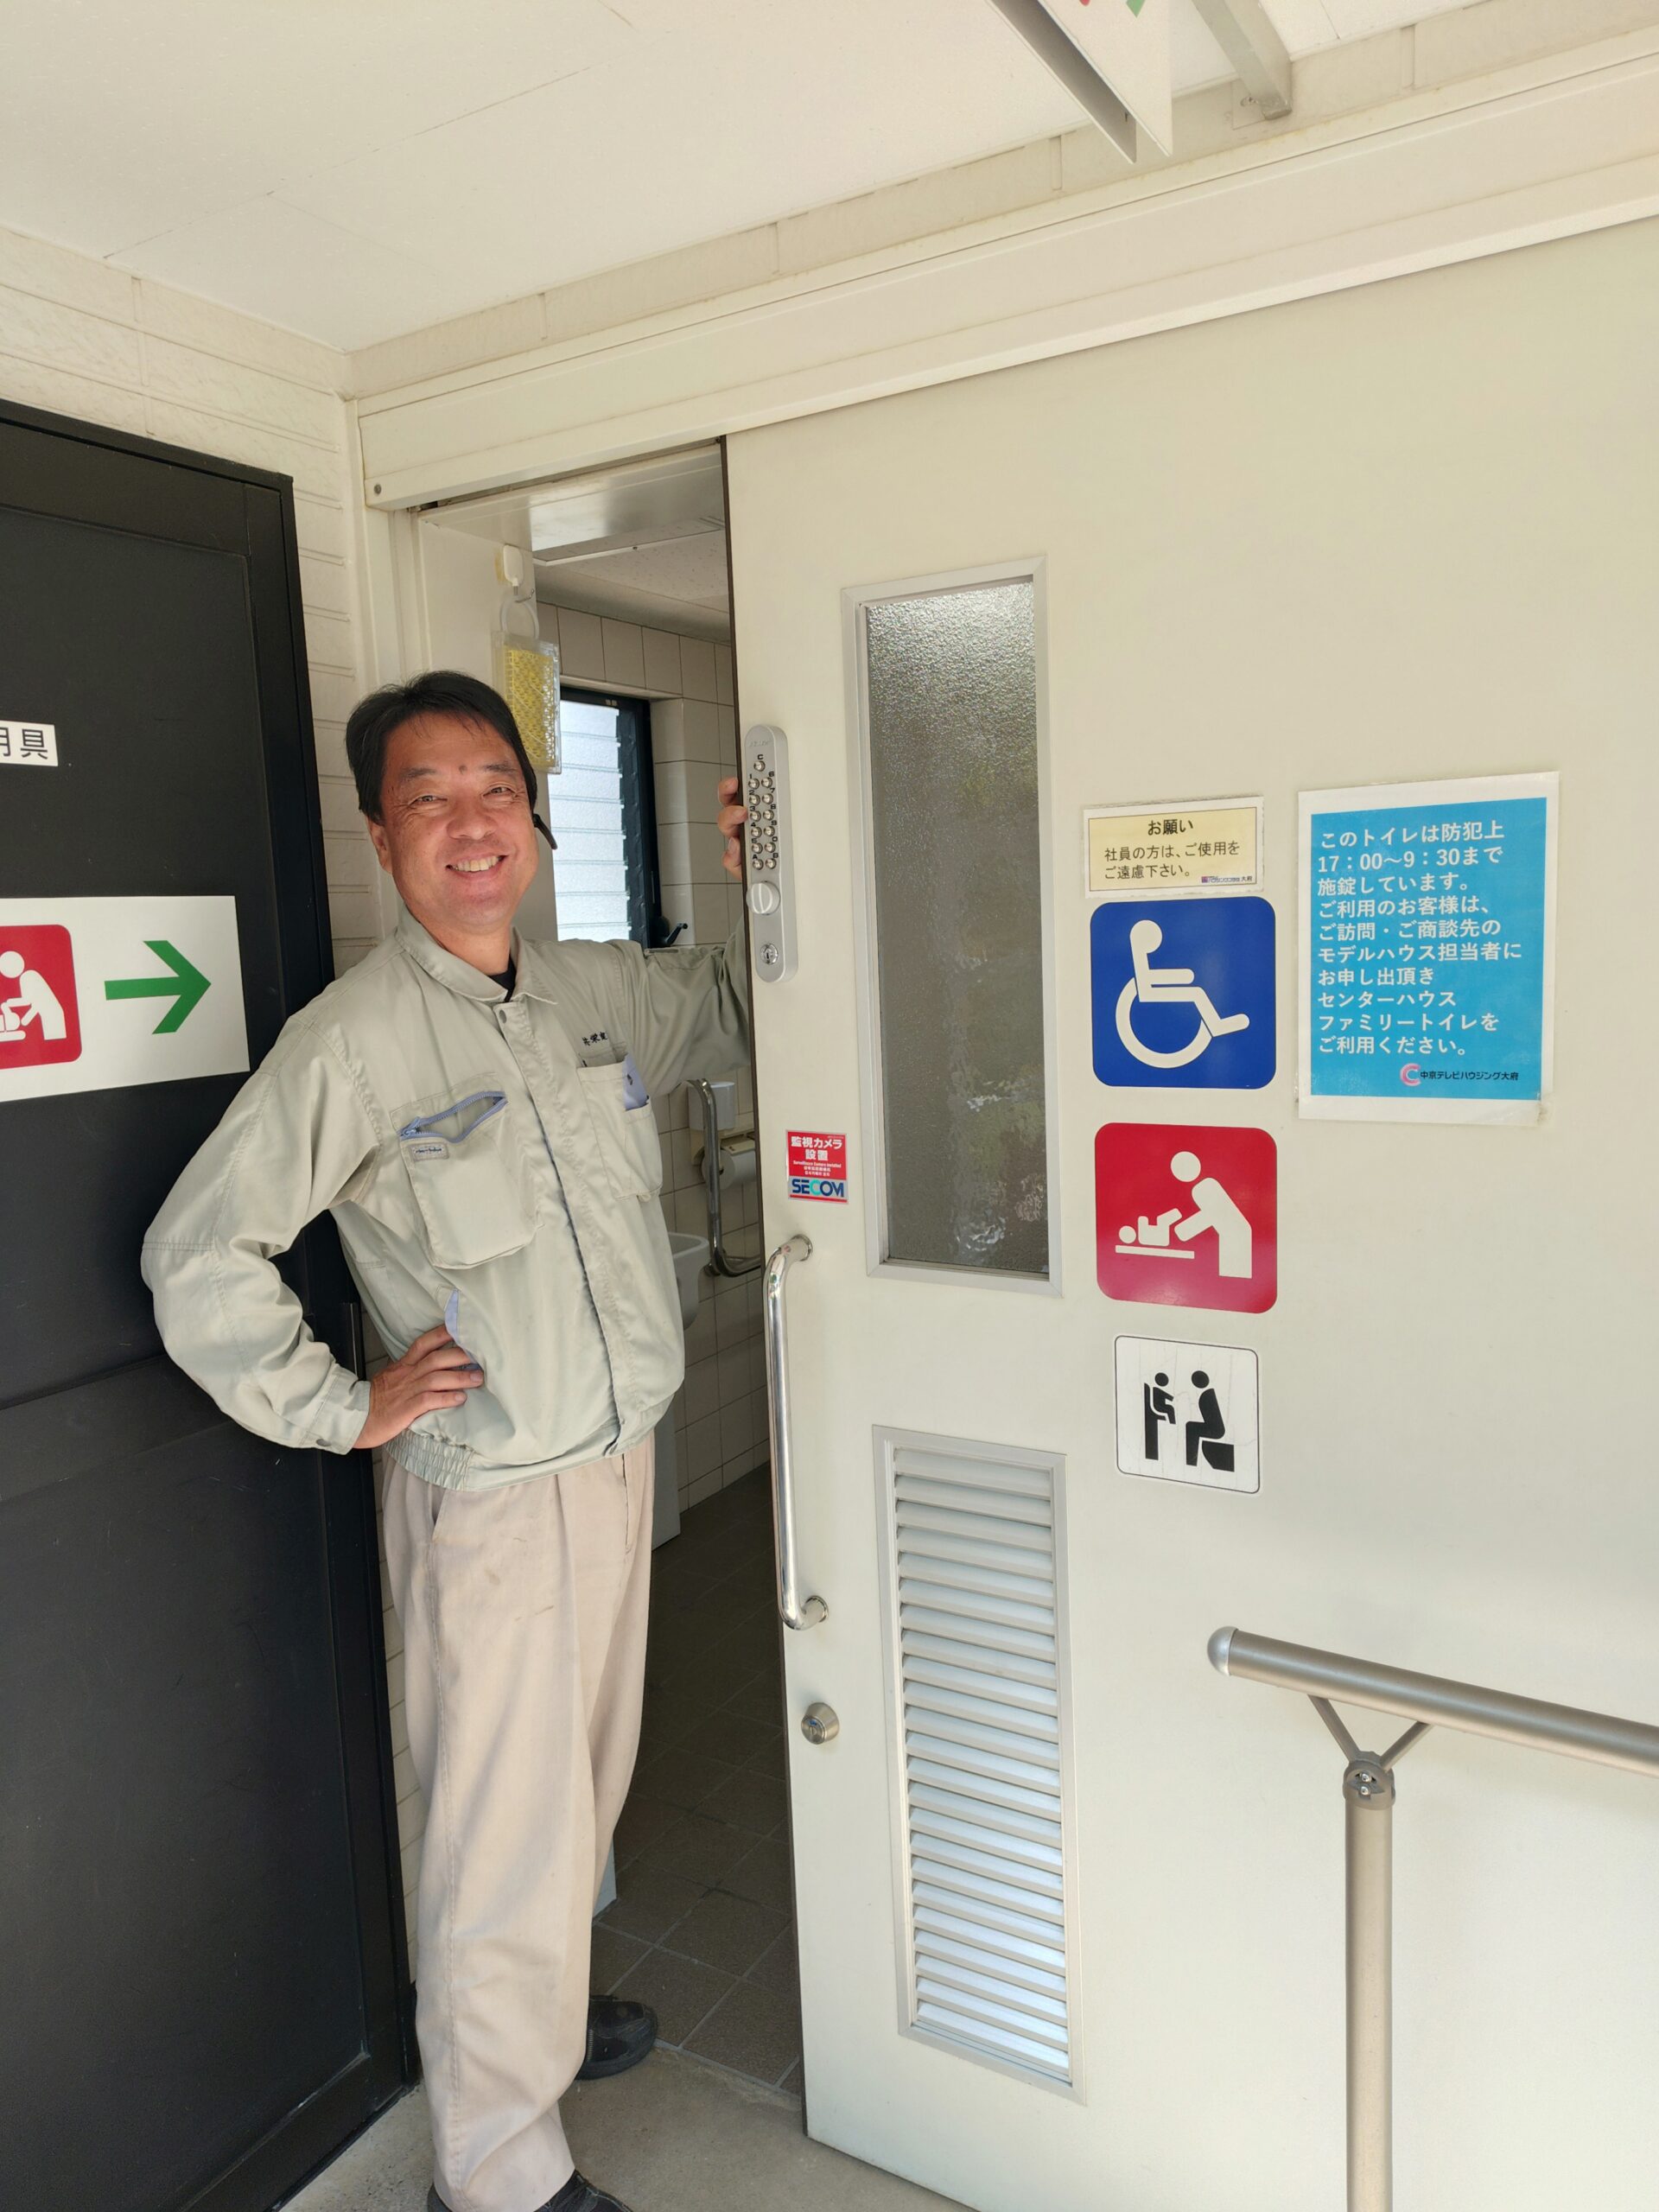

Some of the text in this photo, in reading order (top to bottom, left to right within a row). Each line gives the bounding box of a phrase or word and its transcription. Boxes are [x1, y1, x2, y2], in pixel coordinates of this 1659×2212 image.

[1147, 819, 1193, 836] お願い
[1321, 820, 1504, 849] このトイレは防犯上
[1104, 841, 1240, 861] 社員の方は、ご使用を
[1104, 863, 1190, 880] ご遠慮下さい。
[1317, 872, 1468, 897] 施錠しています。
[1319, 895, 1489, 918] ご利用のお客様は、
[1319, 918, 1501, 941] ご訪問・ご商談先の
[1318, 942, 1522, 963] モデルハウス担当者に
[1318, 968, 1434, 986] お申し出頂き
[1318, 990, 1457, 1008] センターハウス
[1319, 1013, 1499, 1032] ファミリートイレを
[1319, 1036, 1465, 1056] ご利用ください。
[1420, 1071, 1519, 1081] 中京テレビハウジング大府
[791, 1135, 843, 1150] 監視カメラ
[791, 1178, 844, 1198] SECOM
